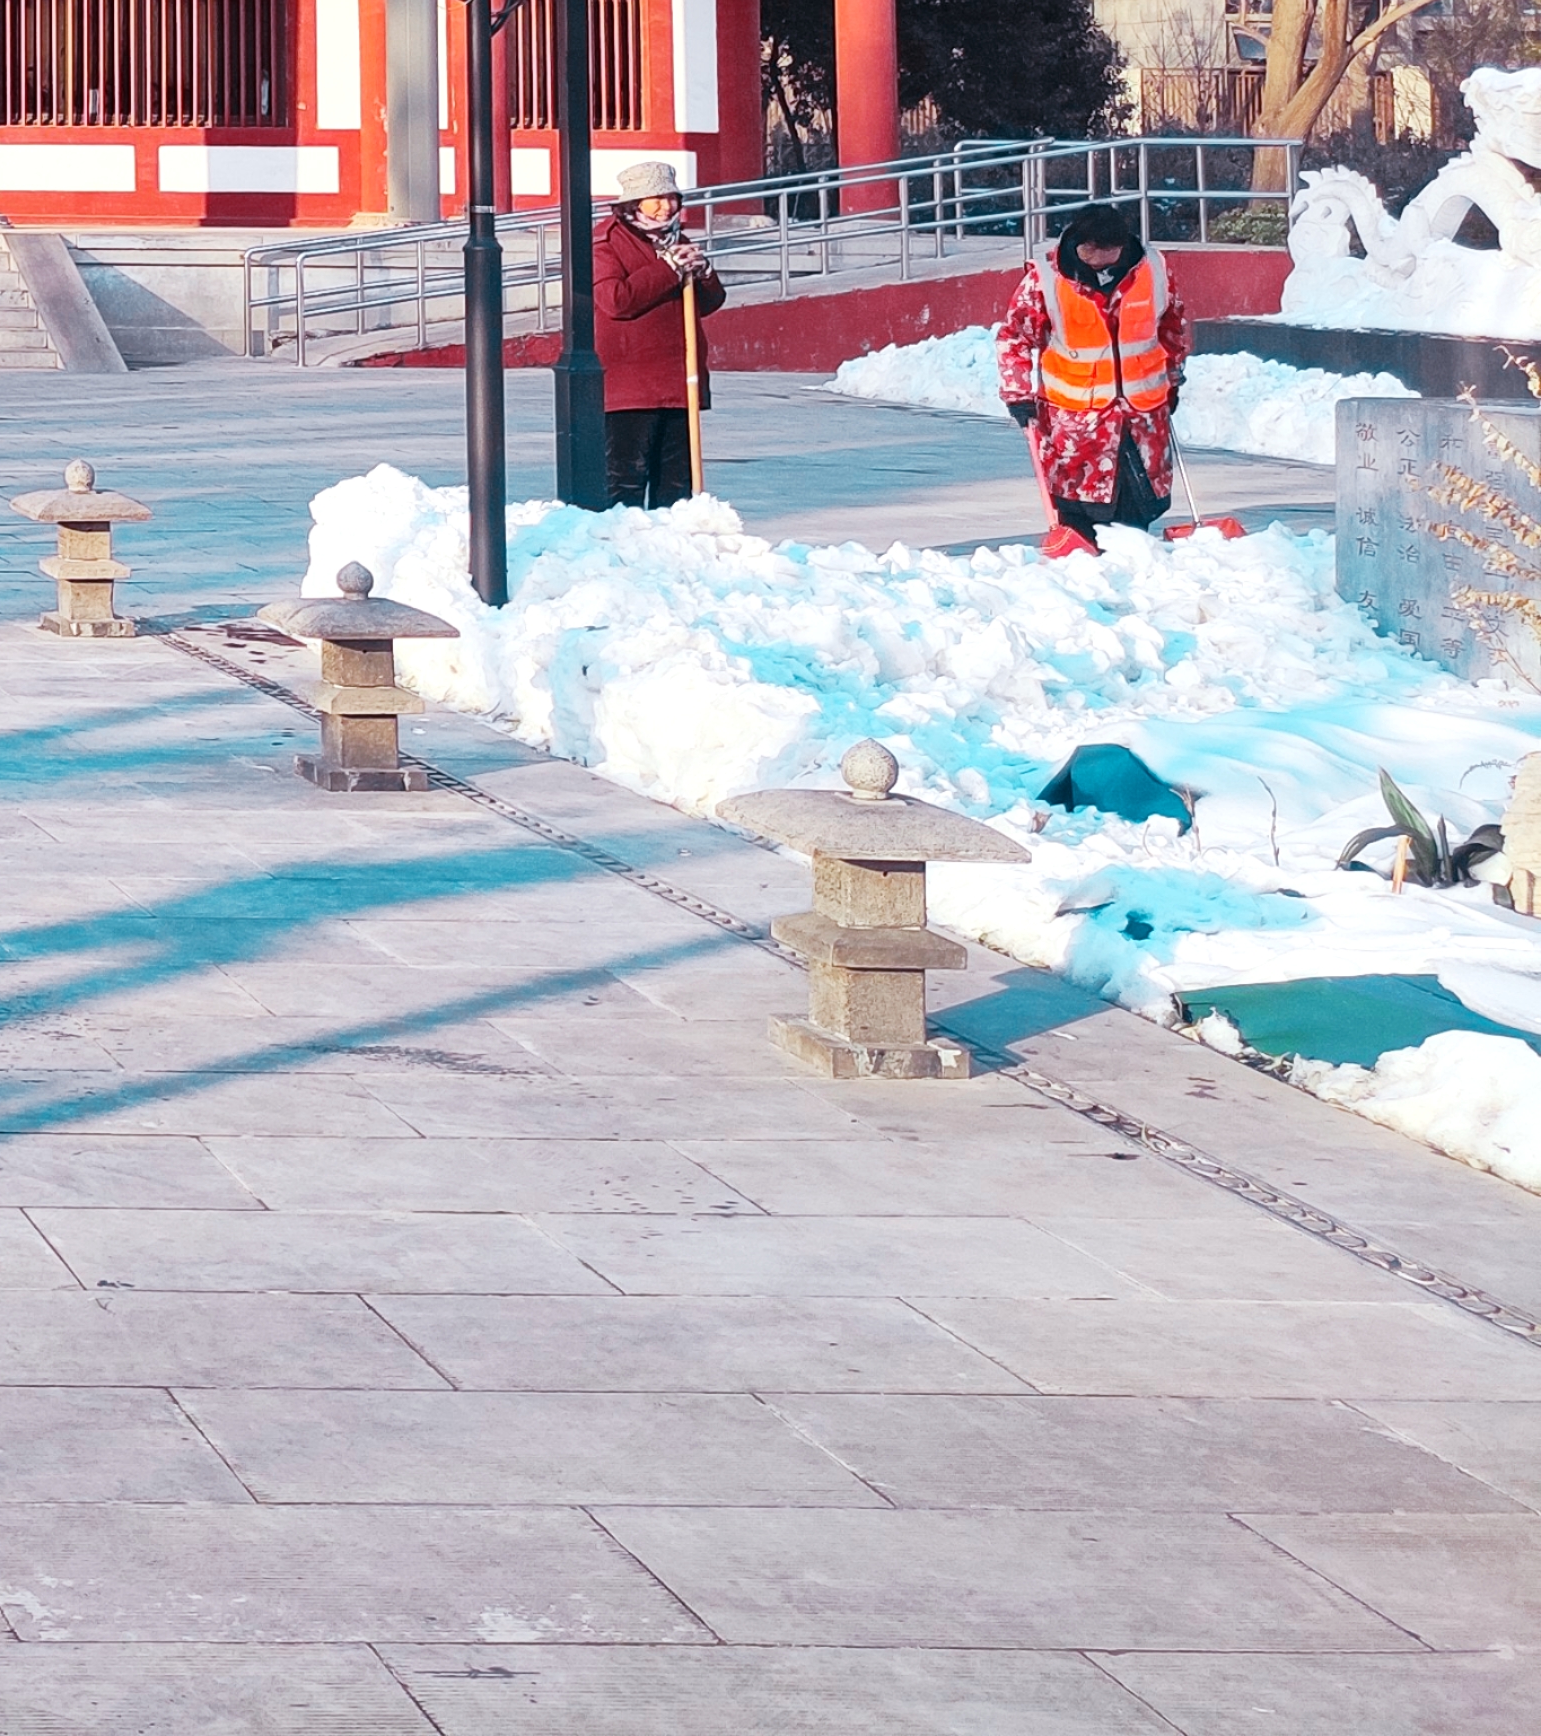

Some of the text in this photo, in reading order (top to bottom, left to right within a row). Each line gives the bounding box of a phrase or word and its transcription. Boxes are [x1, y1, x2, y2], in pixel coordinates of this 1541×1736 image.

[1355, 422, 1379, 472] 敬业
[1396, 428, 1421, 478] 公正
[1355, 507, 1380, 558] 诚信
[1397, 516, 1421, 564] 法治
[1440, 605, 1467, 660] 平等
